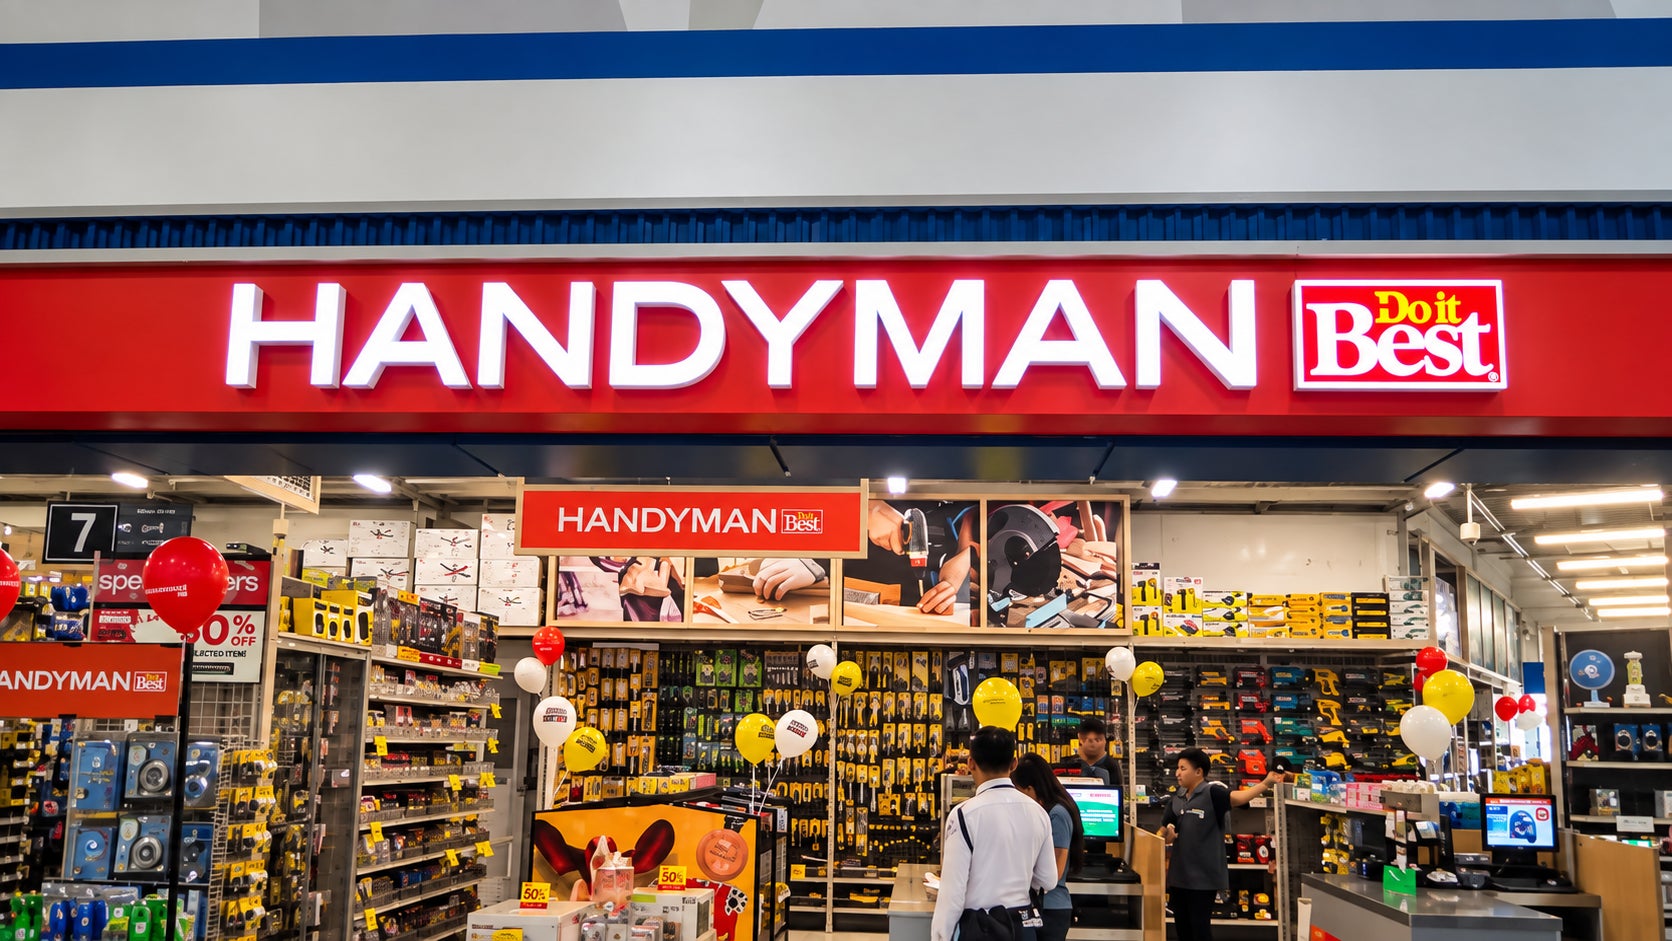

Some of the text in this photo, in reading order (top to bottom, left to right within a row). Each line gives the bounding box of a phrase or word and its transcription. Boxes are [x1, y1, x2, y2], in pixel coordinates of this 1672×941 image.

[1374, 291, 1462, 324] Do it
[225, 280, 1257, 389] HANDYMAN
[1306, 302, 1494, 376] Best
[71, 512, 97, 552] 7
[558, 507, 777, 534] HANDYMAN
[784, 514, 820, 532] Best
[99, 574, 143, 595] spe
[227, 575, 259, 591] ers
[231, 636, 257, 647] OFF
[0, 670, 131, 691] ANDYMAN
[136, 675, 163, 690] Best
